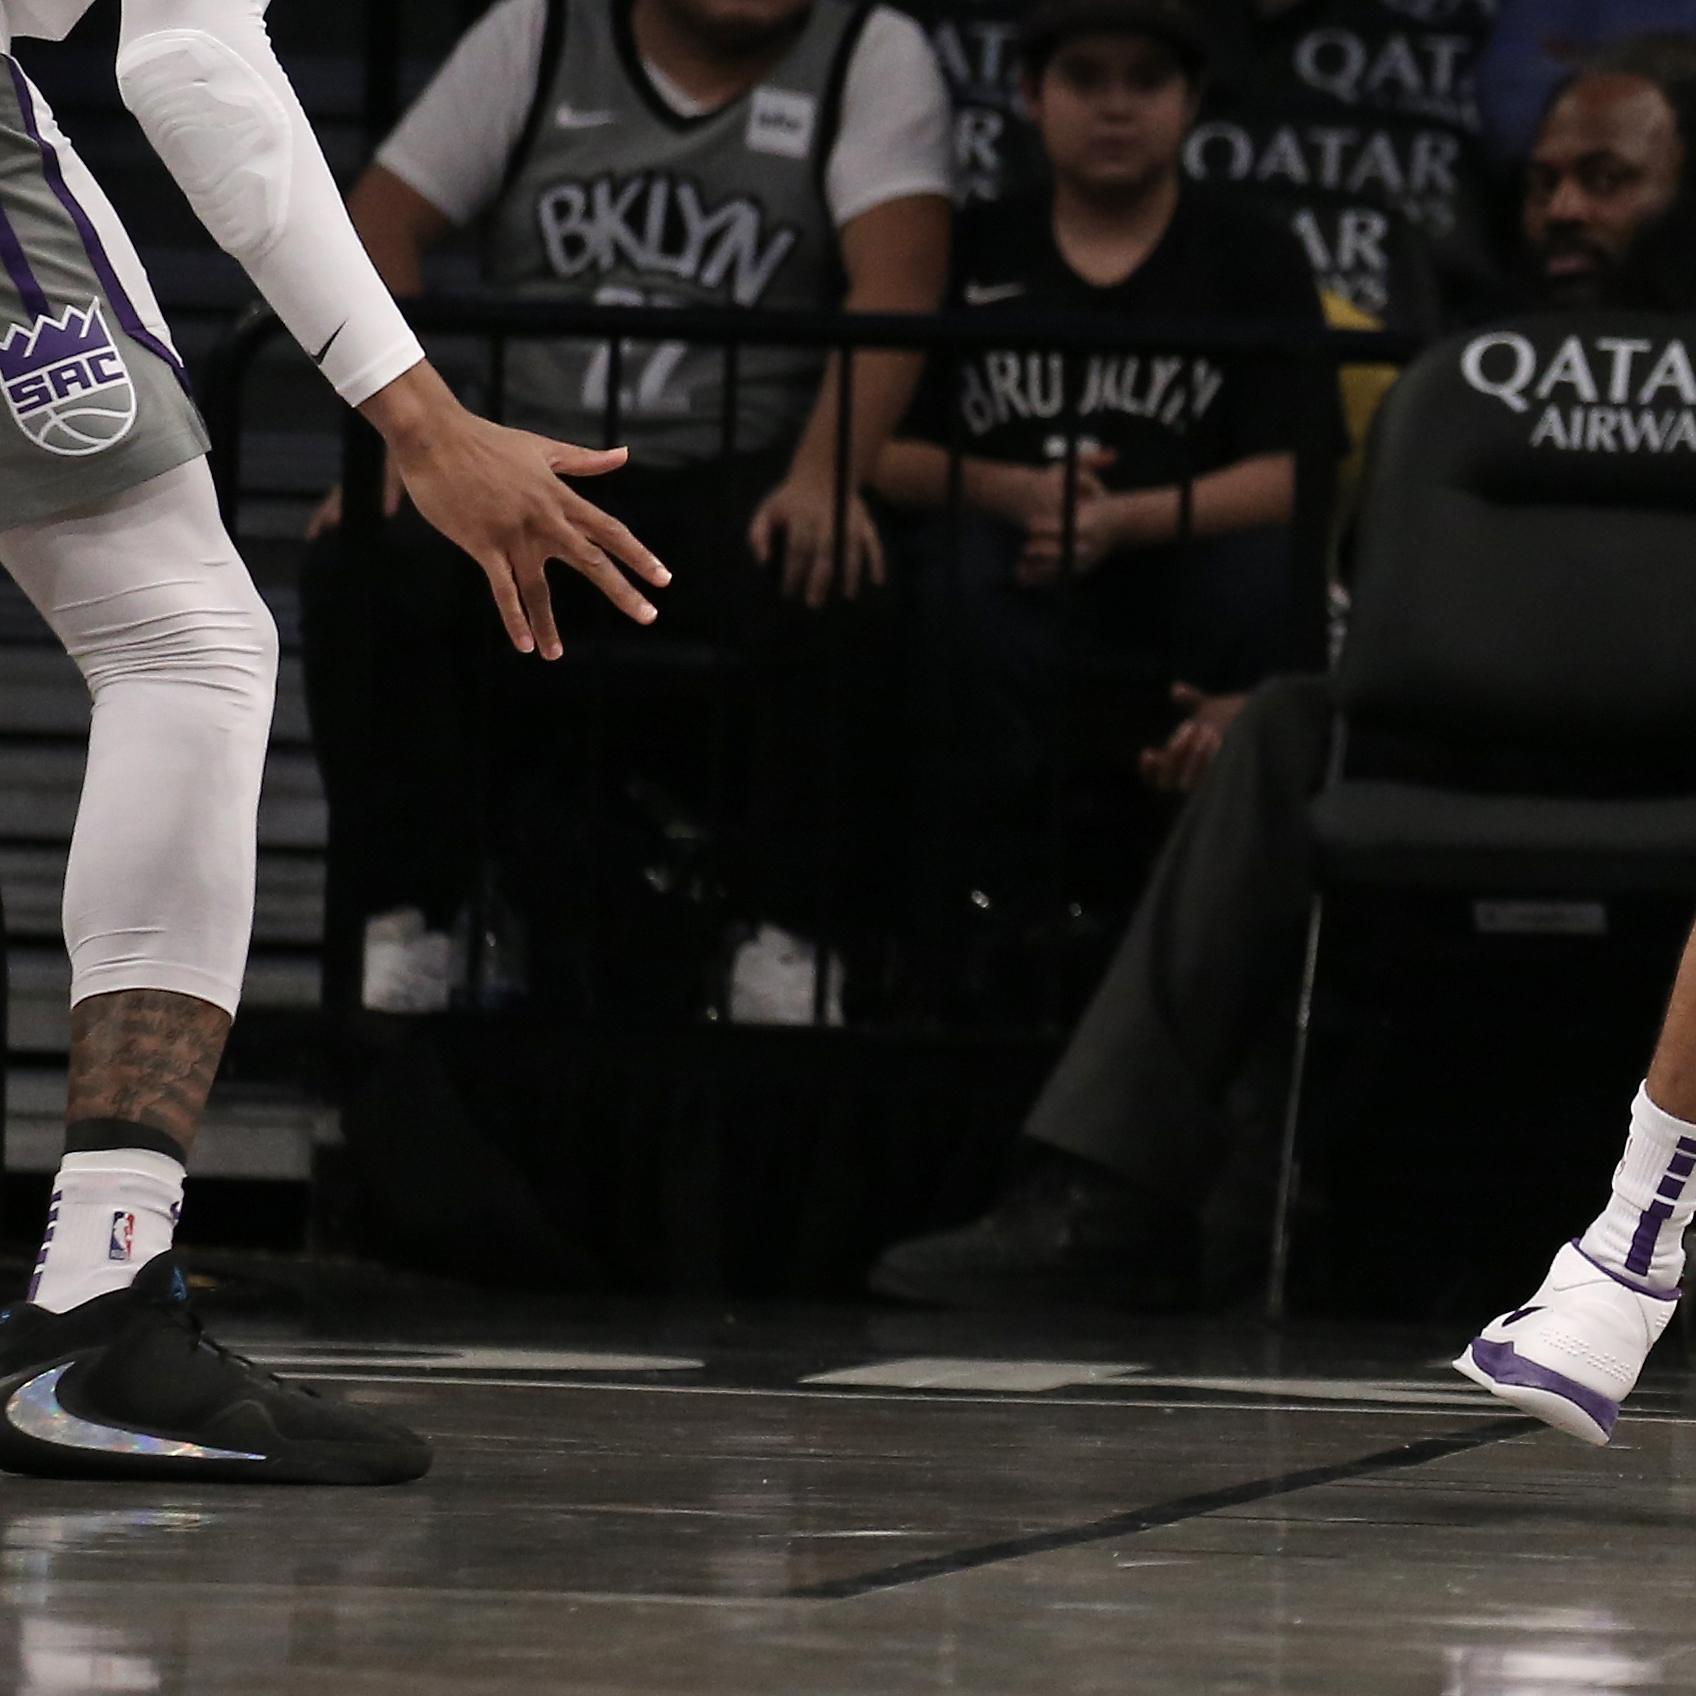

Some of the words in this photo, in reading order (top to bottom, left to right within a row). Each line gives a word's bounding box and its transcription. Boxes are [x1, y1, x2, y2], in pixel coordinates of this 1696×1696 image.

[1293, 26, 1482, 105] QAT
[538, 174, 797, 308] BKLYN
[7, 350, 126, 415] SAC
